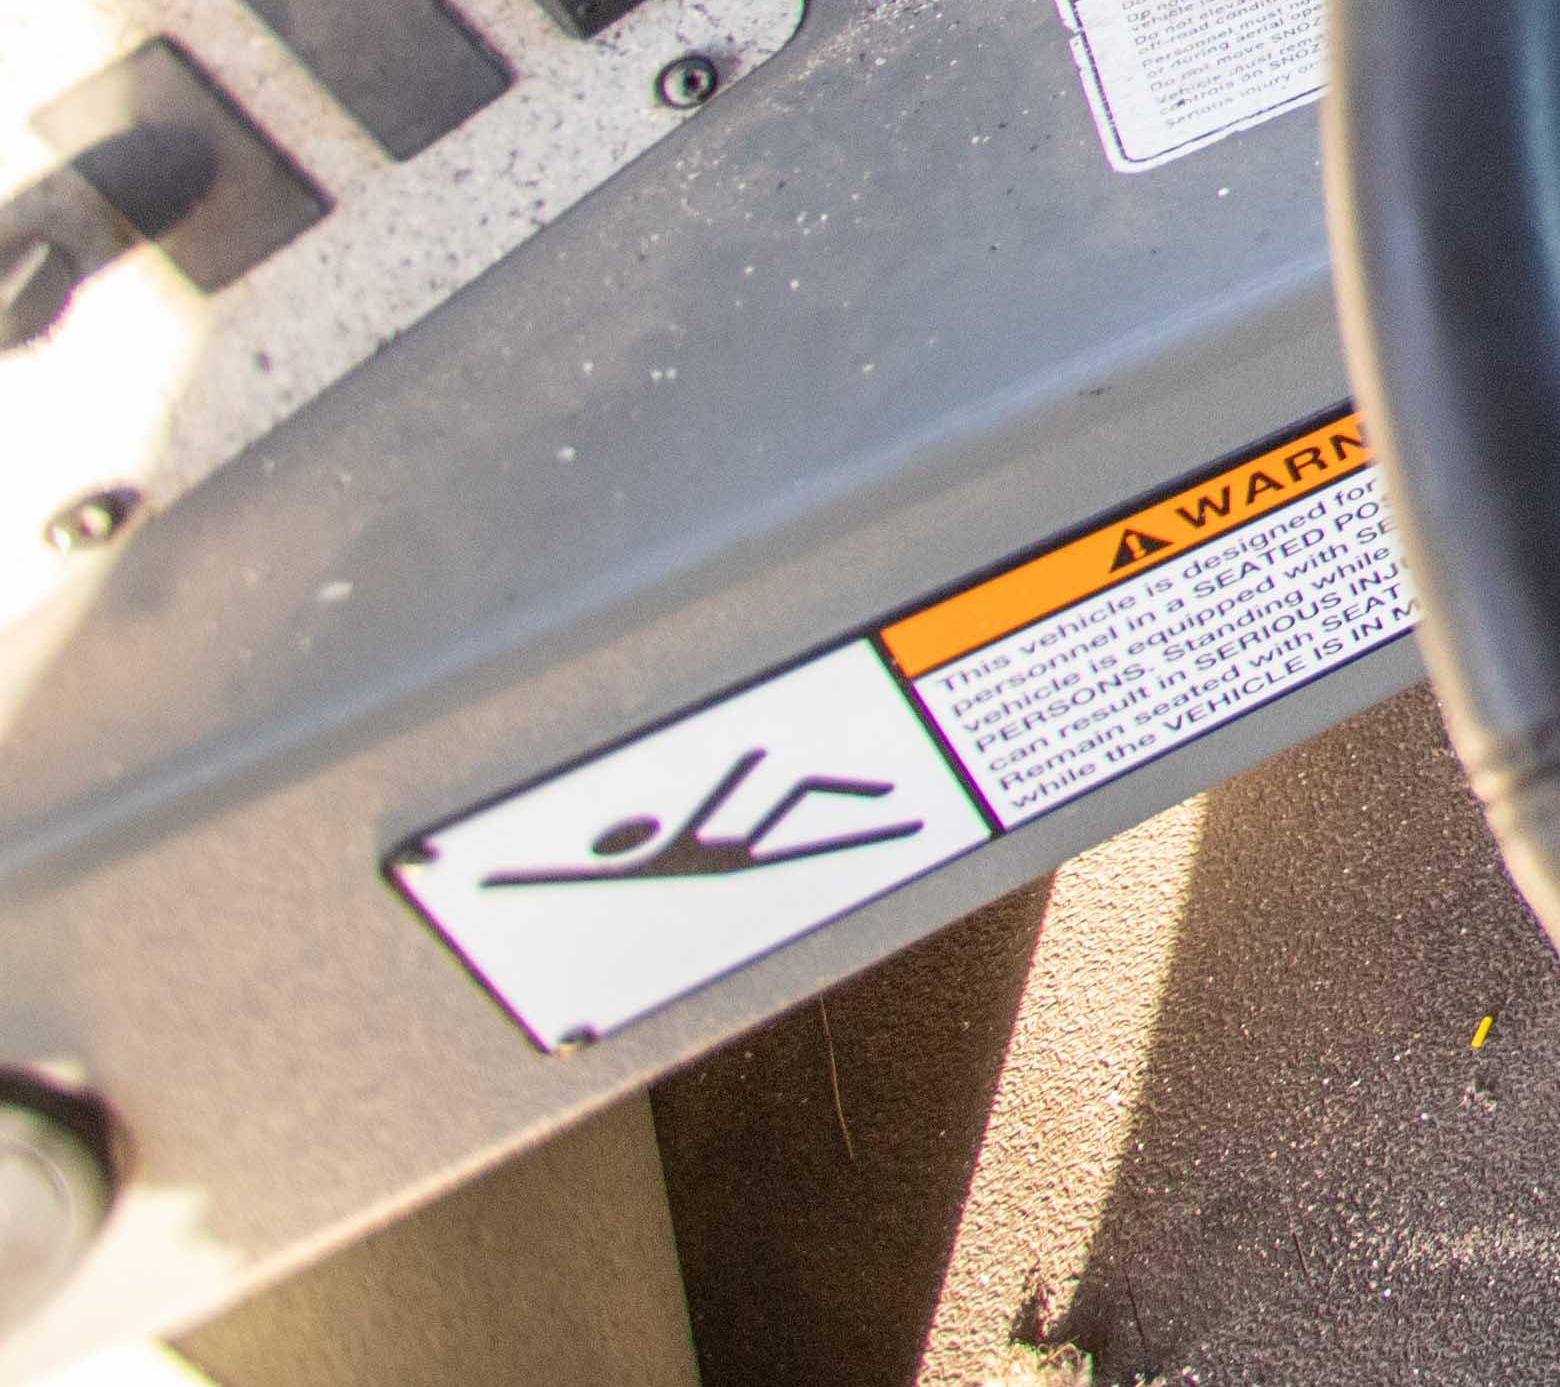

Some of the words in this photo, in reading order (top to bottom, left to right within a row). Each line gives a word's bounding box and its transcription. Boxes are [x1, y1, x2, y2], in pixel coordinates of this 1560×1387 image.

[1175, 432, 1368, 532] WARN
[940, 652, 1012, 695] This
[1019, 594, 1138, 655] vehicle
[1144, 576, 1175, 599] is
[1183, 502, 1328, 581] designed
[1334, 477, 1379, 506] for
[949, 627, 1121, 717] personnel
[1193, 529, 1325, 600] SEATED
[973, 662, 1157, 753] PERSONS.
[1162, 588, 1307, 667] Standing
[1312, 547, 1392, 592] while
[1056, 684, 1154, 741] result
[1194, 588, 1343, 672] SERIOUS
[1125, 576, 1276, 661] equipped
[1282, 542, 1350, 580] with
[998, 723, 1126, 793] Remain
[1133, 665, 1242, 727] seated
[1320, 582, 1403, 632] SEAT
[1009, 761, 1098, 810] while
[1104, 733, 1158, 765] the
[1160, 656, 1307, 733] VEHICLE
